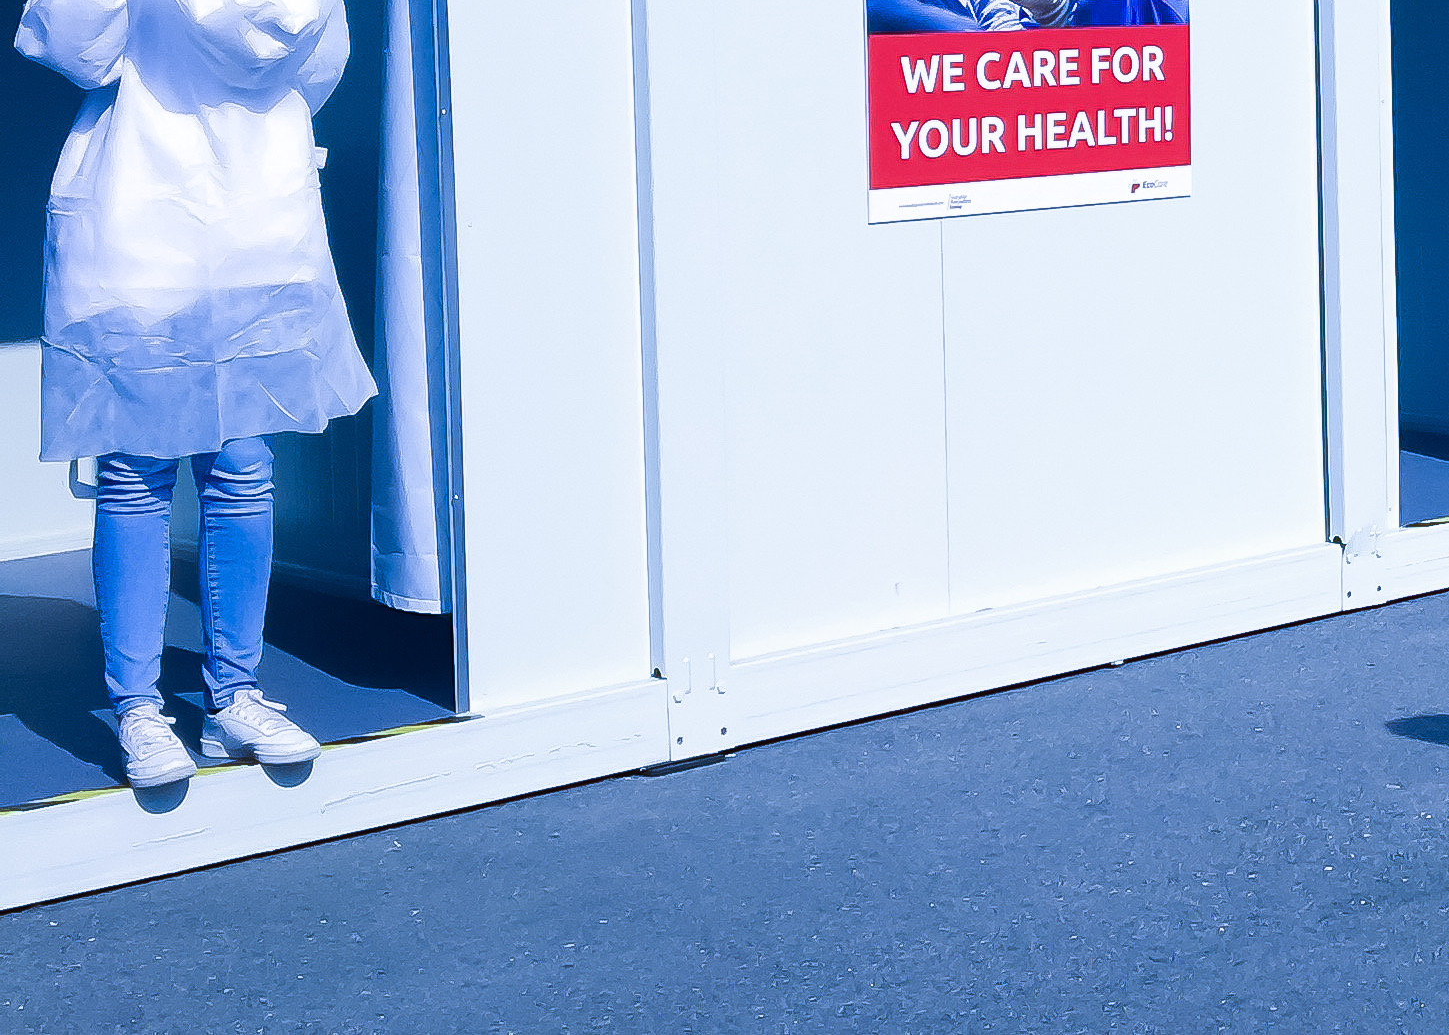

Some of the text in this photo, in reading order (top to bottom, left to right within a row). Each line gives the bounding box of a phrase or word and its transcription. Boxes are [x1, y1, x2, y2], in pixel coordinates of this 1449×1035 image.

[900, 45, 1165, 94] WE CARE FOR
[890, 105, 1174, 160] YOUR HEALTH!
